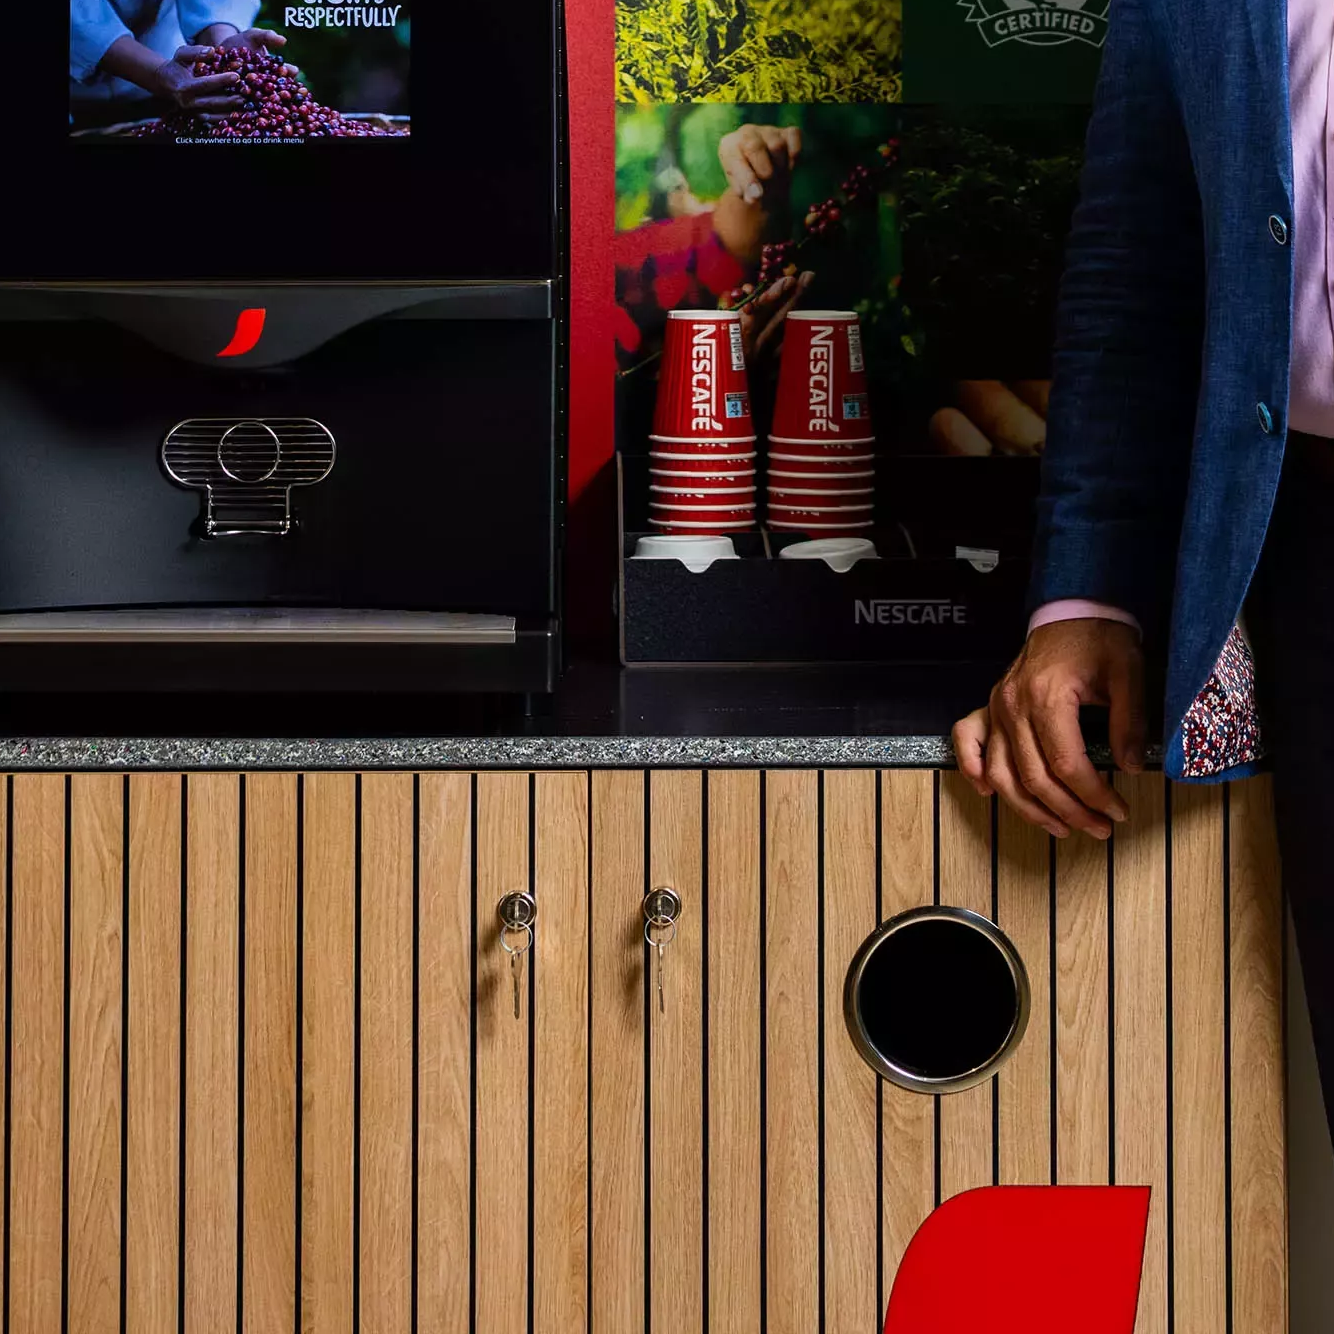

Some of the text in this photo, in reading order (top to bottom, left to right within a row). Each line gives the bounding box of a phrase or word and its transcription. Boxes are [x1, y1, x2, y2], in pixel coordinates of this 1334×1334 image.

[285, 5, 402, 29] RESPECTFULLY
[994, 11, 1095, 35] CERTIFIED
[175, 136, 194, 145] Click
[195, 137, 231, 145] anywhere
[232, 136, 241, 145] to
[253, 136, 262, 145] to
[263, 136, 282, 145] drink
[692, 324, 723, 431] NESCAFÉ
[809, 325, 840, 432] NESCAFÉ
